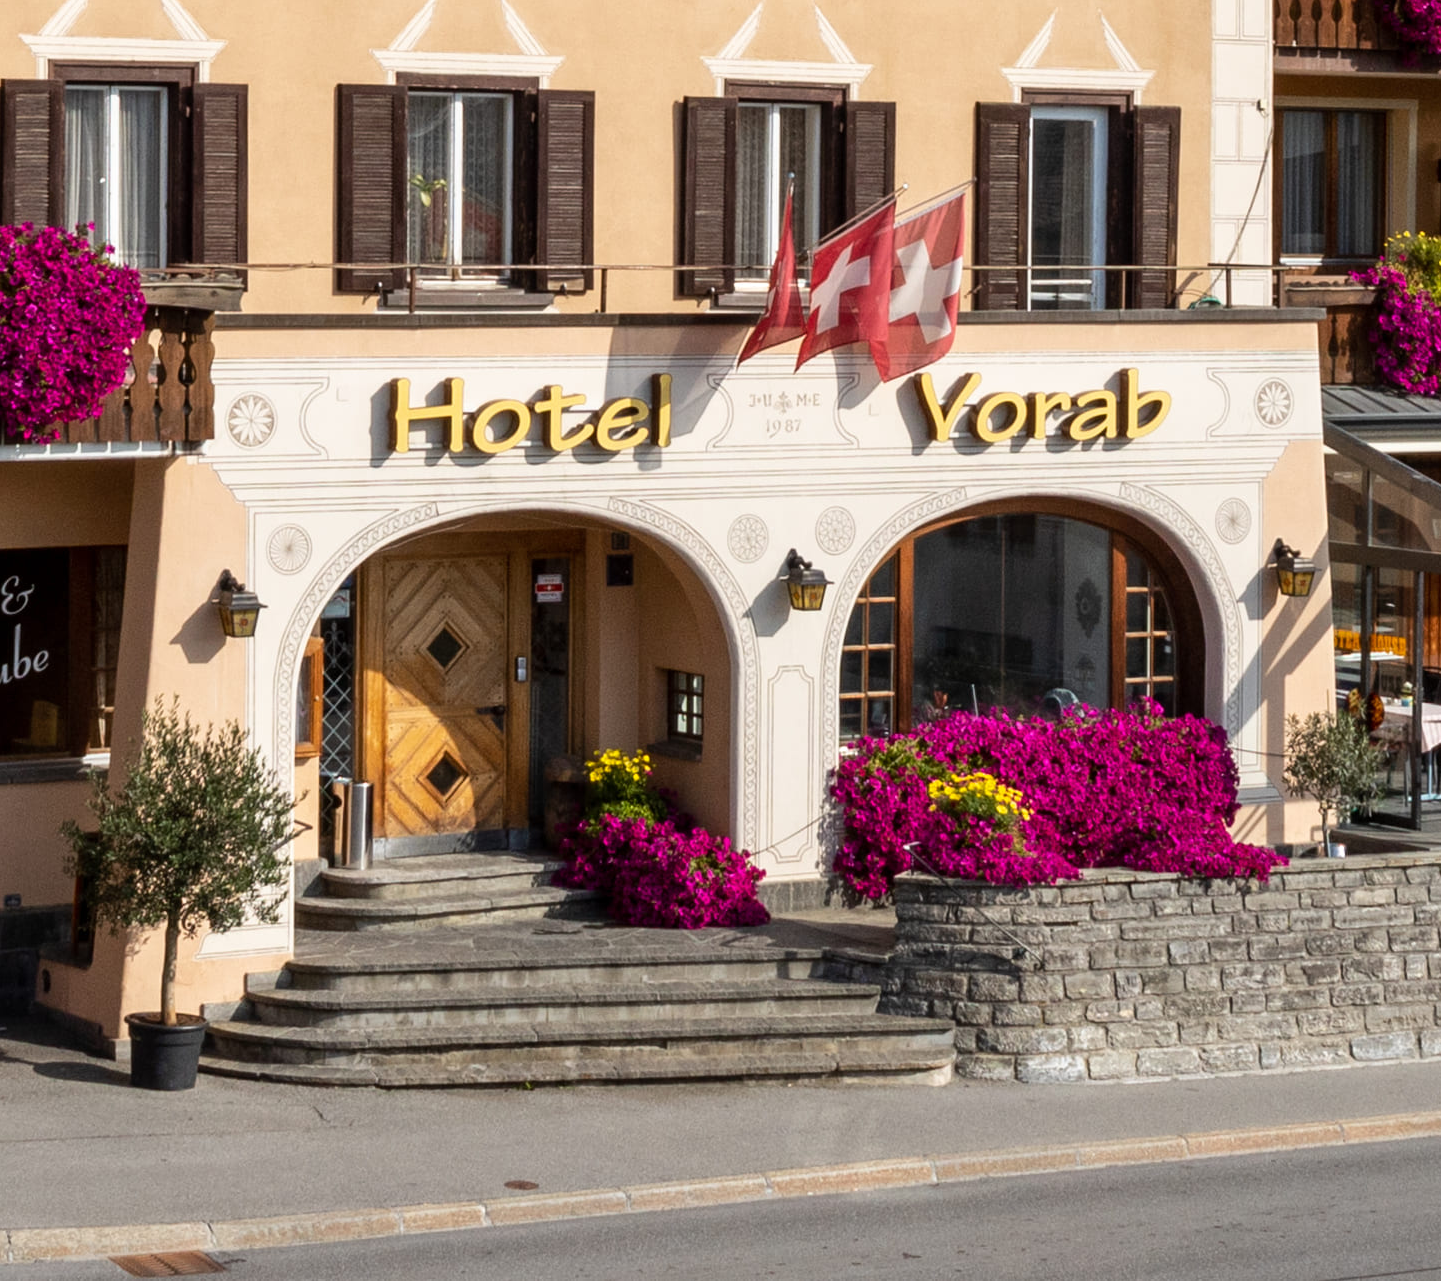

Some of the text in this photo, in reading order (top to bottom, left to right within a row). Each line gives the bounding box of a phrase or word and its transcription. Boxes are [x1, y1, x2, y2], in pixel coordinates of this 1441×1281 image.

[388, 367, 1172, 454] Hotel Vorab
[766, 418, 801, 439] 1987
